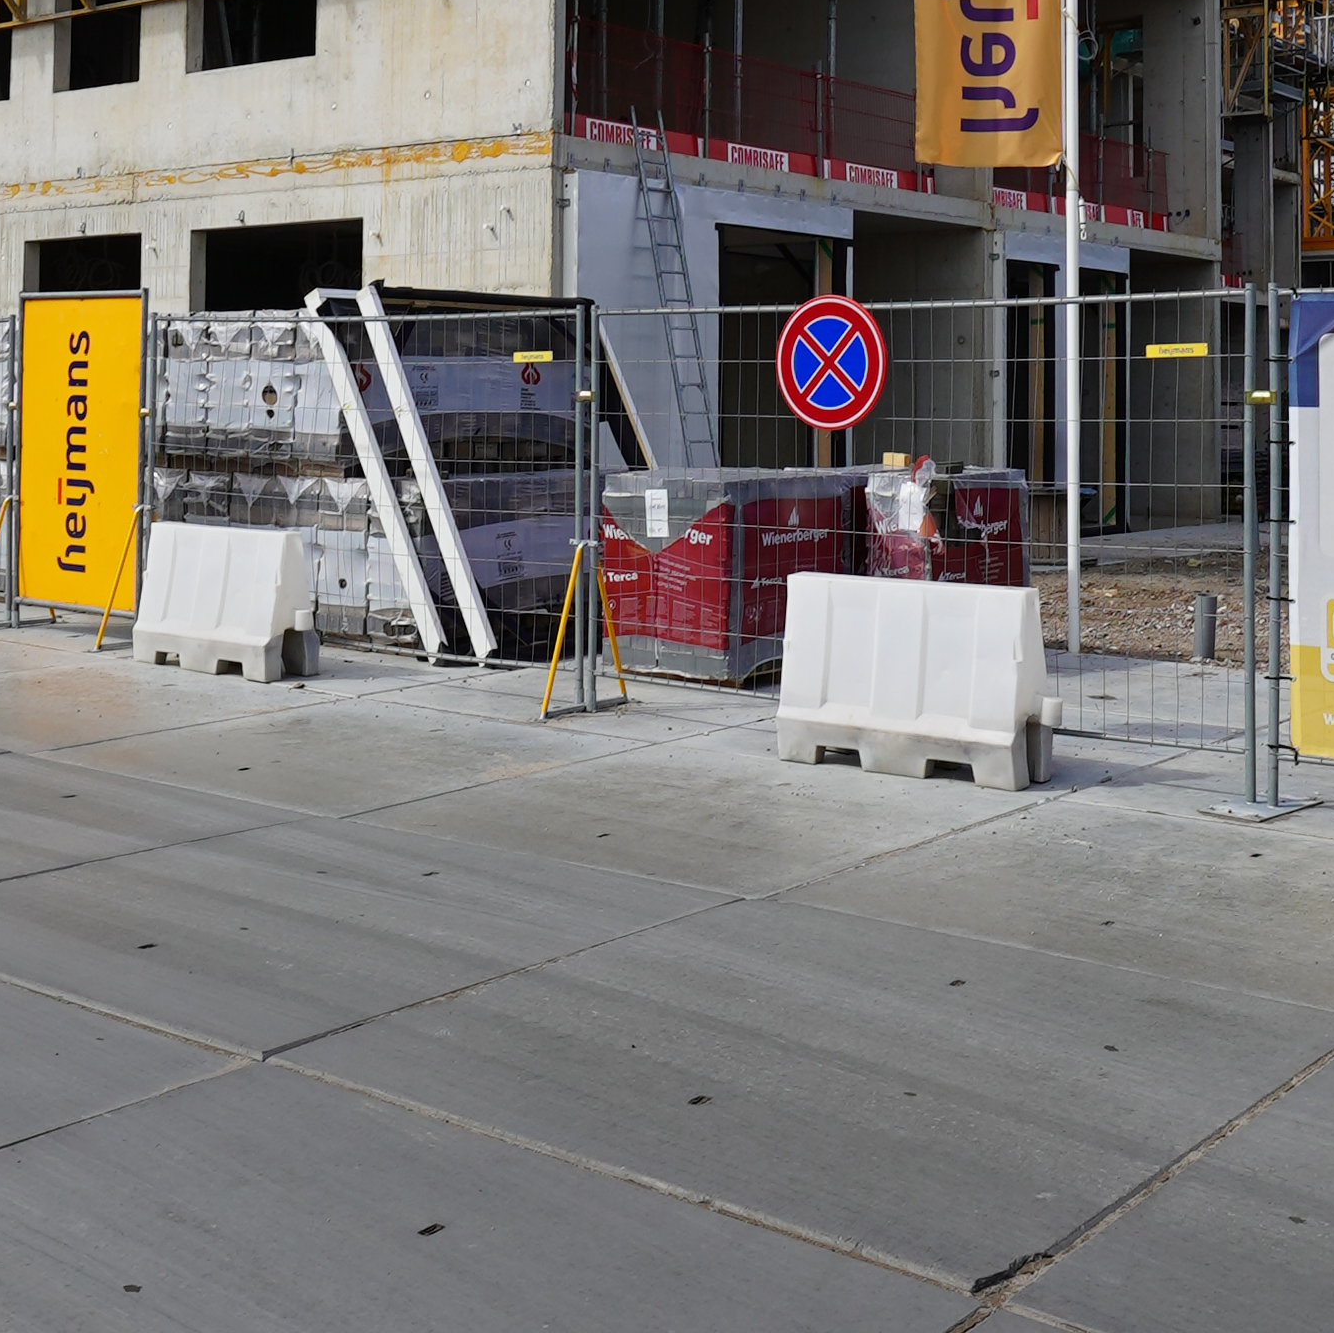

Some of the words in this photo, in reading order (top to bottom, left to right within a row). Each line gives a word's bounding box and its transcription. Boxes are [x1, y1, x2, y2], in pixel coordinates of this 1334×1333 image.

[590, 121, 652, 149] COMBISFE
[731, 146, 785, 172] COMBISAFE
[849, 166, 895, 189] COMBISAFE
[992, 190, 1023, 210] MBISAFE
[57, 330, 95, 573] heijmans
[762, 527, 829, 547] Wienerberger
[607, 572, 639, 583] Terca
